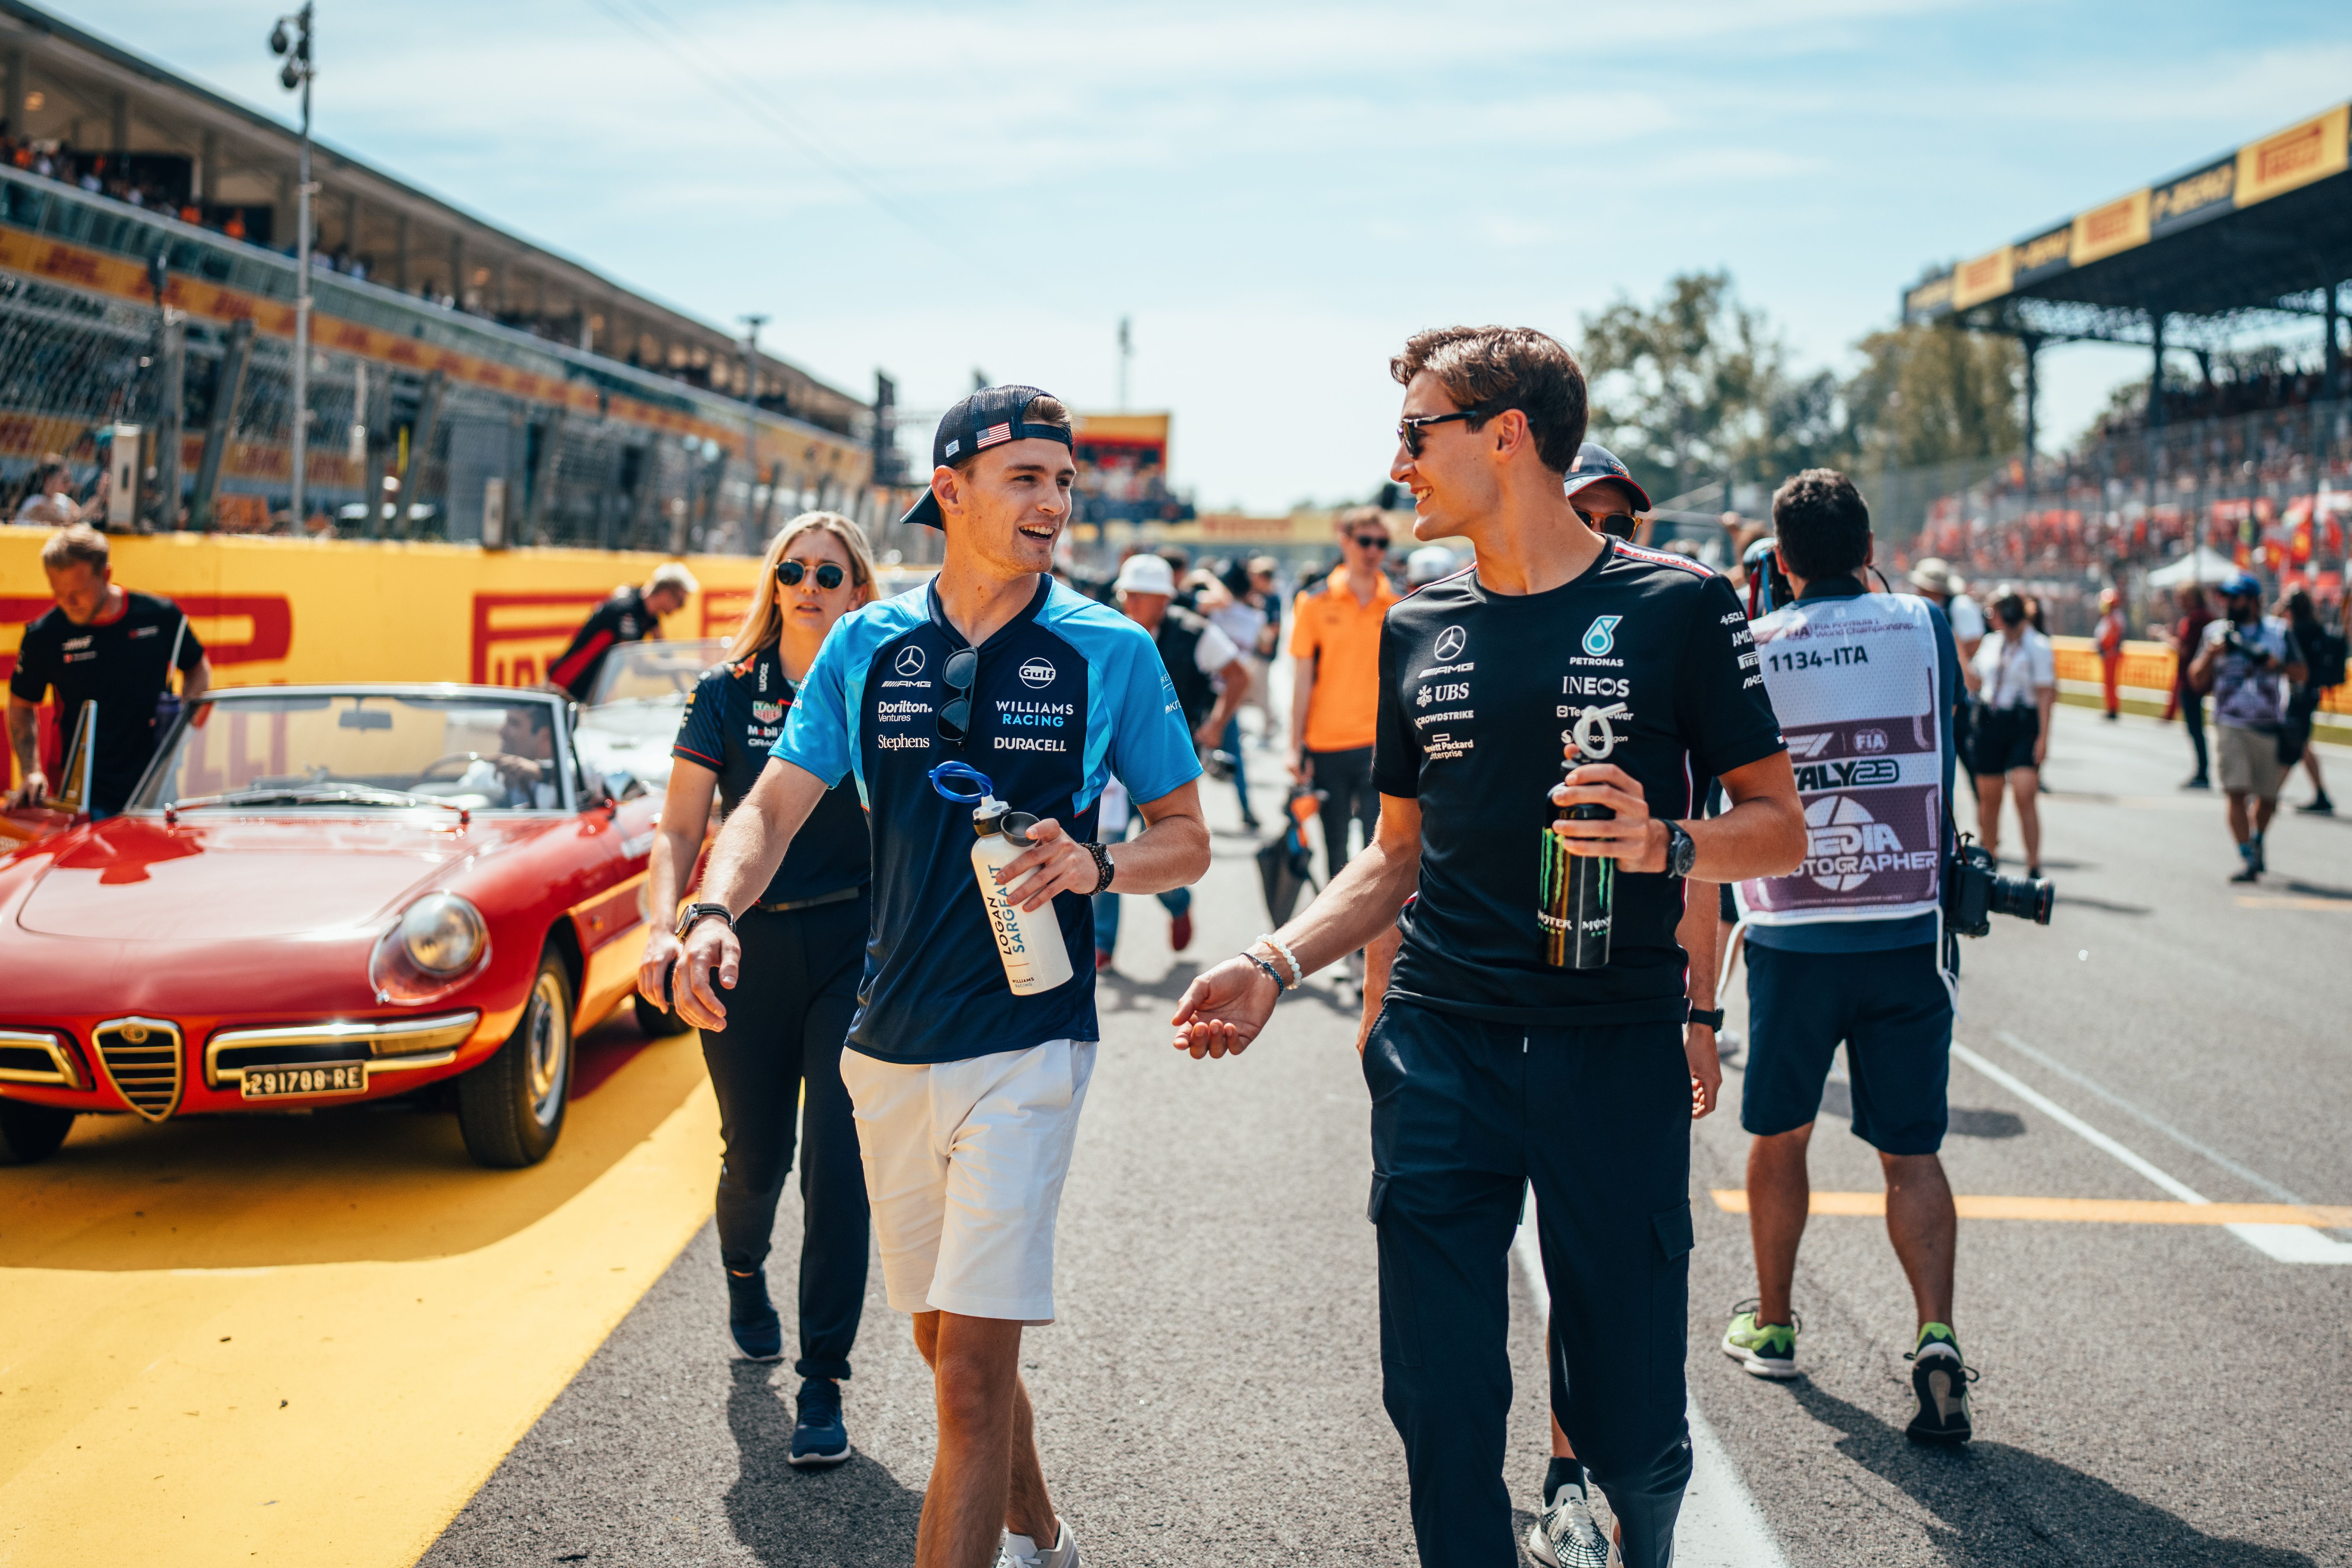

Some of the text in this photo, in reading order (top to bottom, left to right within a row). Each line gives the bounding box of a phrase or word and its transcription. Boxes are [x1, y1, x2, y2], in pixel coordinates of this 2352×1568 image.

[1832, 619, 1873, 628] Formula
[1815, 628, 1844, 638] World
[1569, 657, 1624, 667] PETRONAS
[1769, 645, 1869, 672] 1134-ITA
[759, 662, 769, 692] zoom
[1020, 667, 1055, 679] Gulf
[1435, 682, 1469, 702] UBS
[1562, 676, 1630, 698] INEOS
[996, 701, 1074, 715] WILLIAMS
[878, 714, 911, 722] Ventures
[1003, 714, 1064, 727] RACING
[1417, 710, 1474, 725] CROWDSTRIKE
[747, 724, 778, 738] Mobil
[878, 733, 930, 751] Stephens
[994, 737, 1067, 752] DURACELL
[1441, 739, 1474, 751] Packard
[1856, 734, 1885, 749] FIA
[987, 897, 1012, 955] LOGAN
[251, 1066, 359, 1094] 291708 RE
